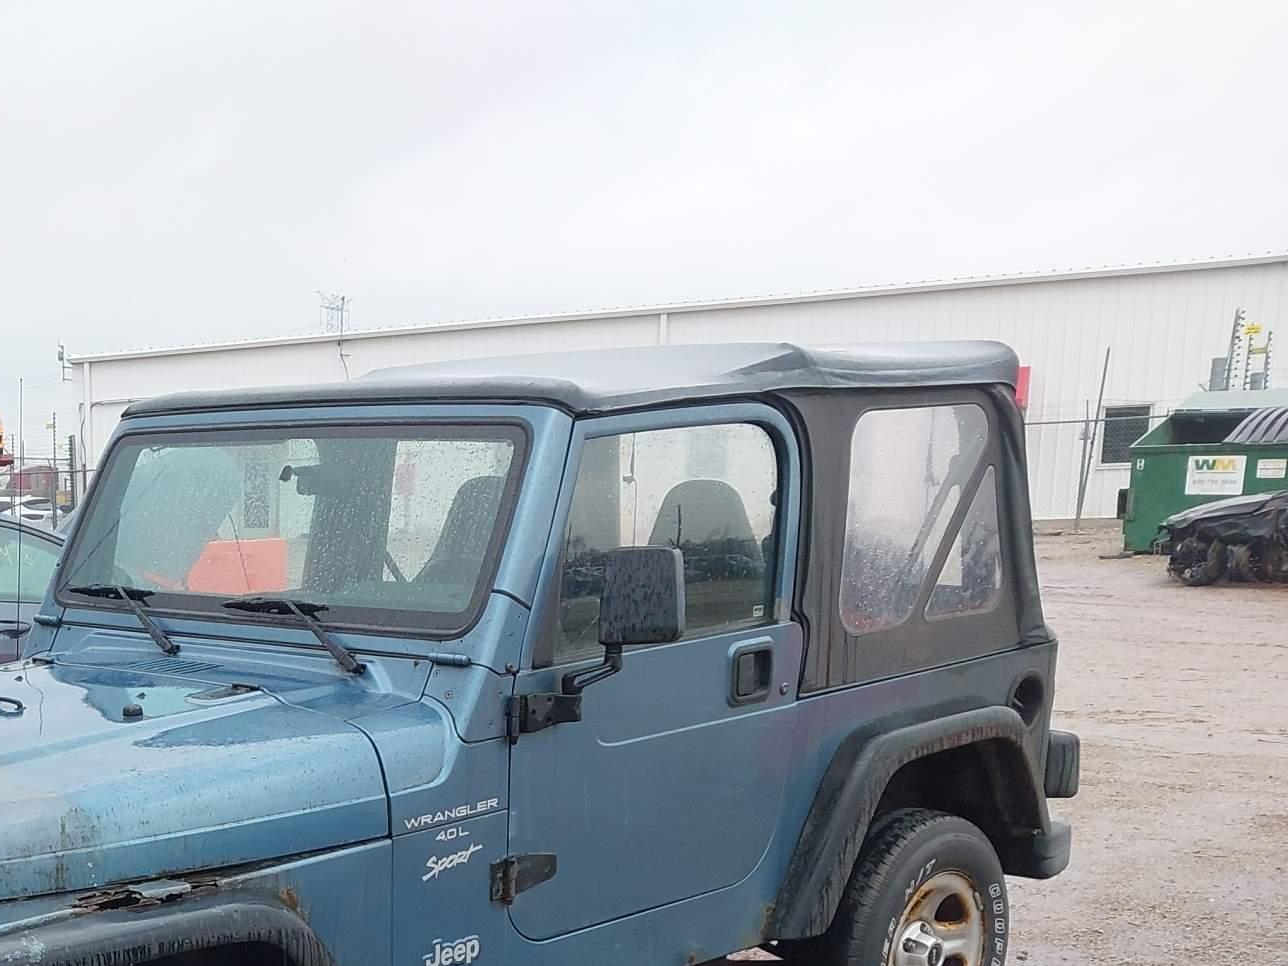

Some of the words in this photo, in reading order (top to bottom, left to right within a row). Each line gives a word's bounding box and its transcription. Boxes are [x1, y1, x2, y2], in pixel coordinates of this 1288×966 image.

[1194, 459, 1237, 471] WM
[404, 798, 499, 829] WRANGLER
[422, 842, 483, 882] Sport
